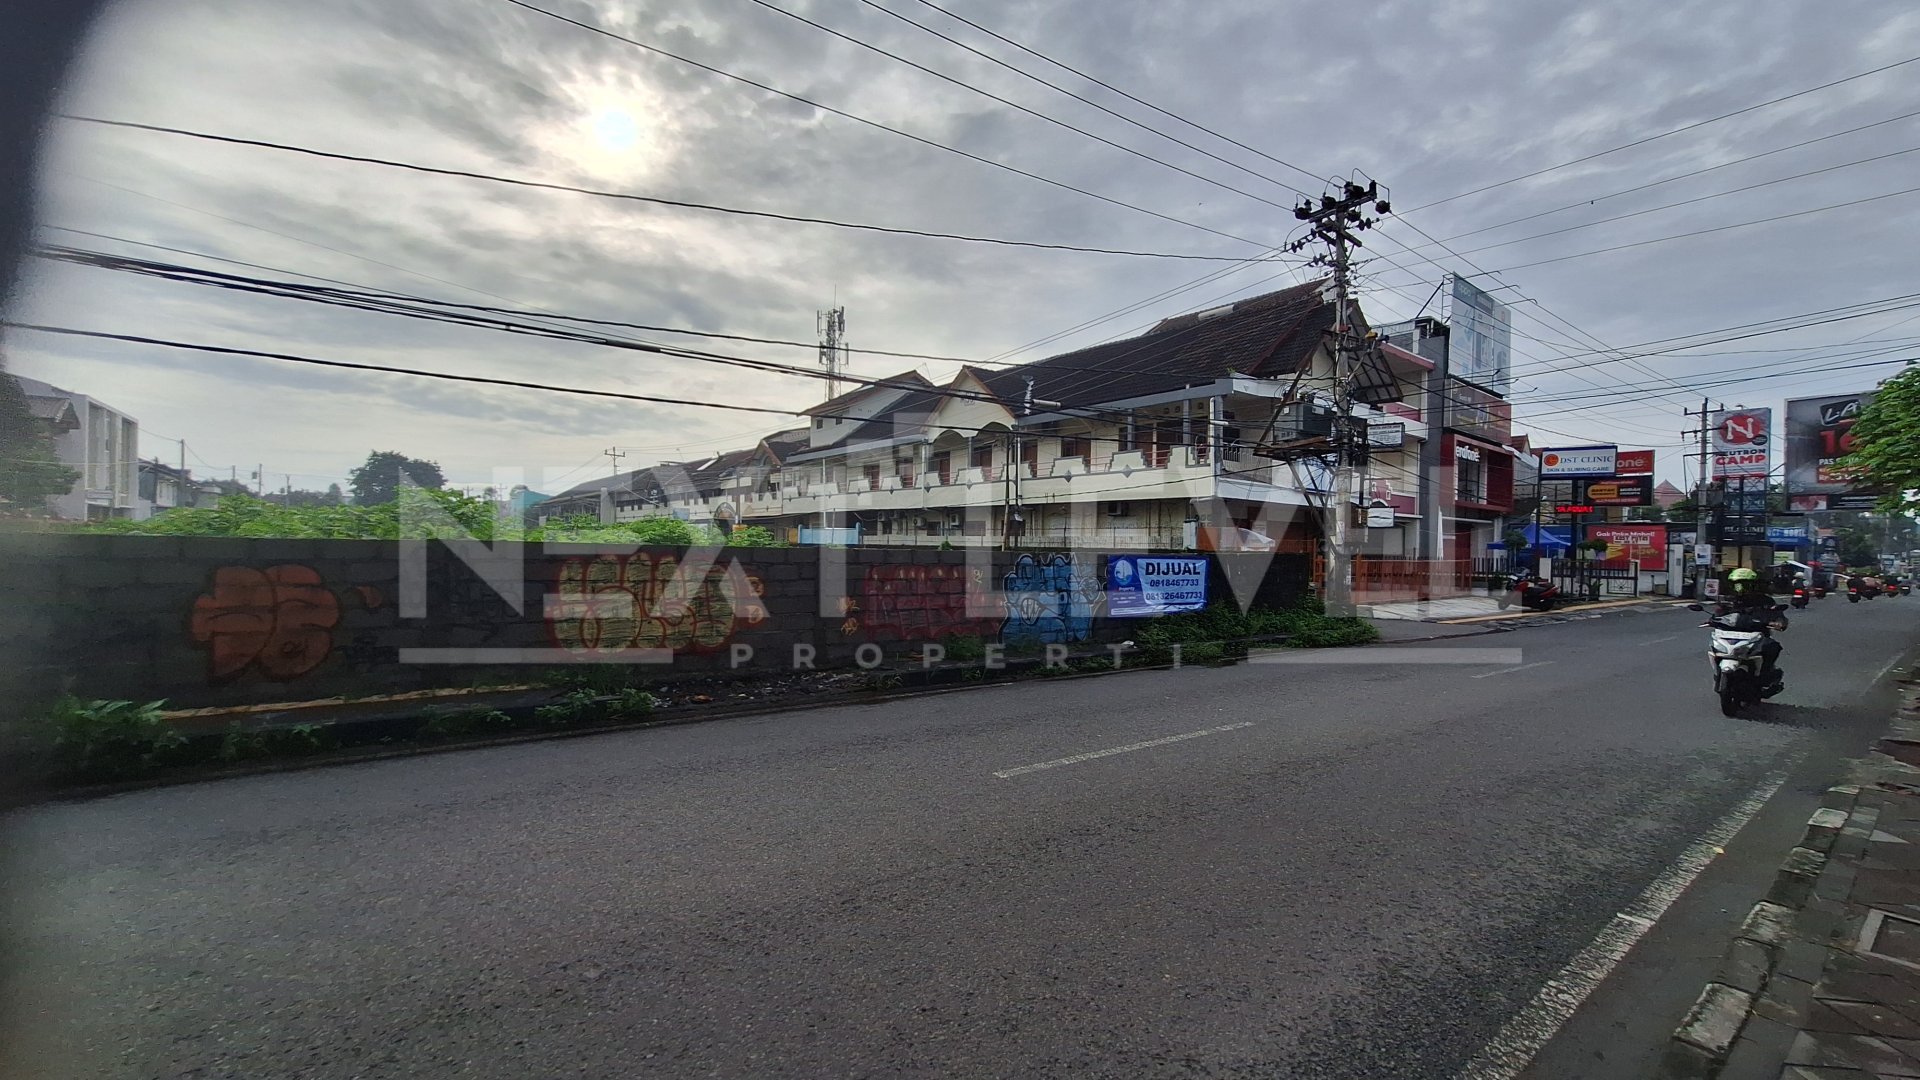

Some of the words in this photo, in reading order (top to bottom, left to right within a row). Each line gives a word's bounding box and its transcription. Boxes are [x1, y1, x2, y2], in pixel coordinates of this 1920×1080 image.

[1716, 448, 1766, 457] EUTRON
[1581, 455, 1614, 463] CLINIC
[1716, 455, 1766, 465] CAMP
[1145, 562, 1201, 576] DIJUAL
[1149, 579, 1199, 587] 0818467733
